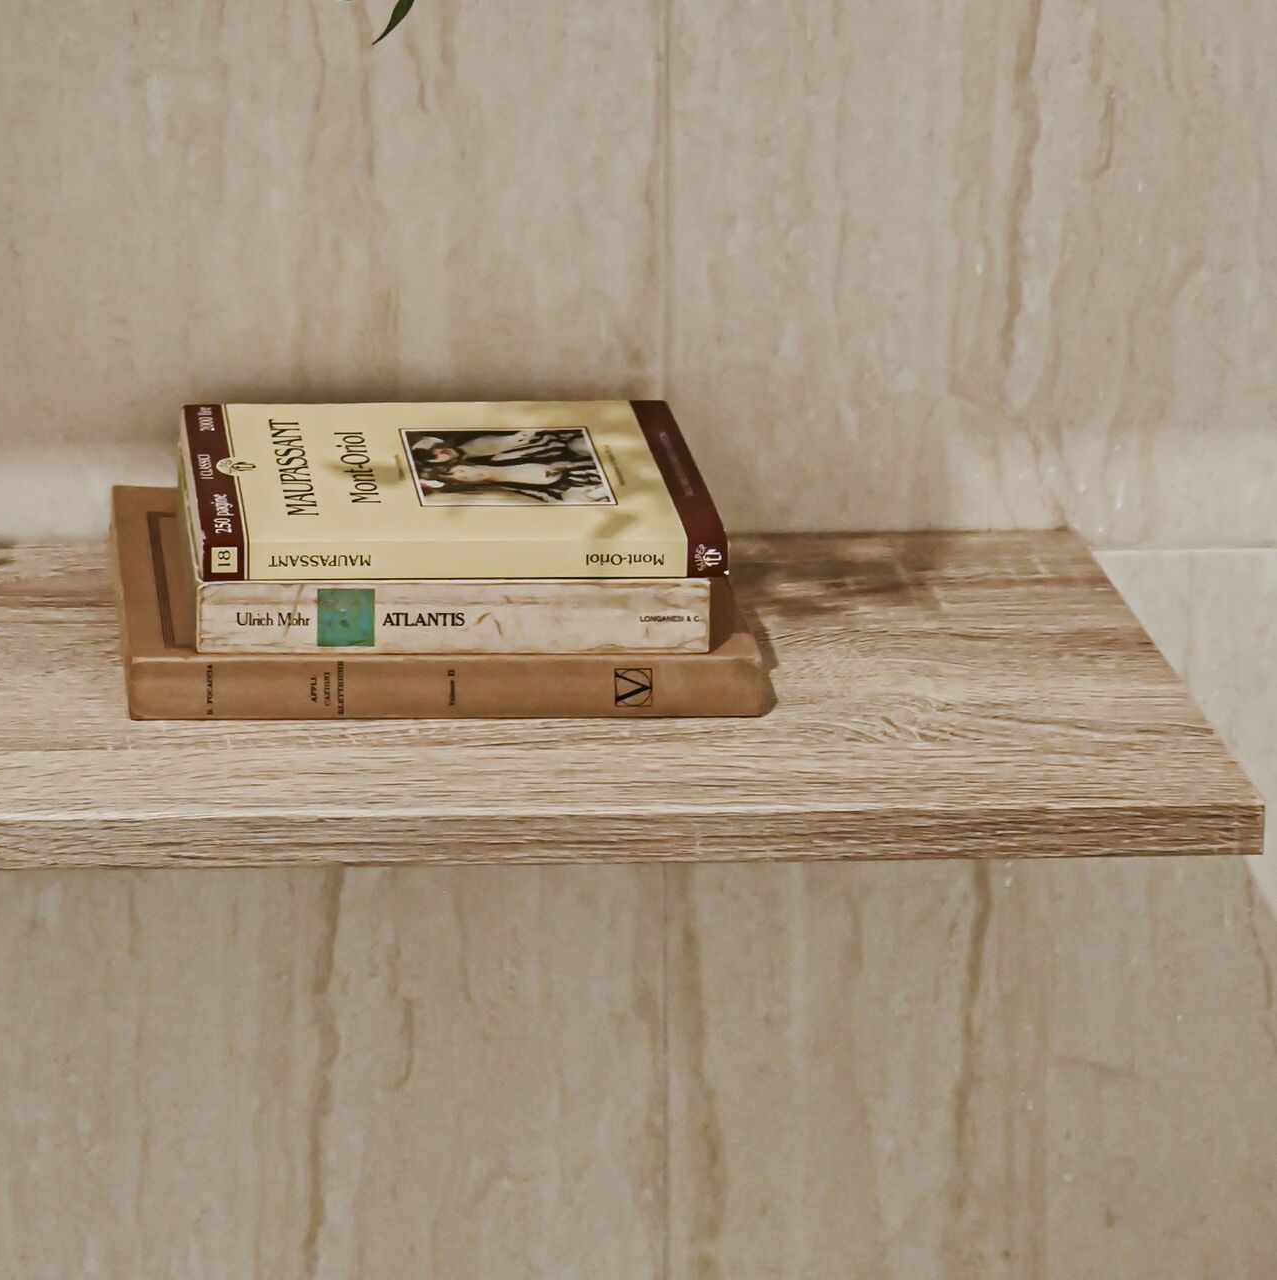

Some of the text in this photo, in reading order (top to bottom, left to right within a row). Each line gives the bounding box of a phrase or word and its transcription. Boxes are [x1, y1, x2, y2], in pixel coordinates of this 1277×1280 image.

[198, 416, 216, 432] 2000
[197, 454, 213, 476] CLASSICI
[268, 418, 319, 516] MAUPASSANT
[334, 431, 382, 504] Mont-Oriol
[210, 493, 235, 534] 250 pagine
[217, 550, 231, 567] 18
[268, 554, 372, 568] MAUPASSANT
[585, 553, 665, 567] Mont-Oriol
[694, 543, 707, 572] SUPER
[236, 611, 311, 627] Ulrich Mohr
[382, 612, 466, 627] ATLANTIS
[639, 615, 685, 623] LONGANESI
[686, 615, 692, 623] &
